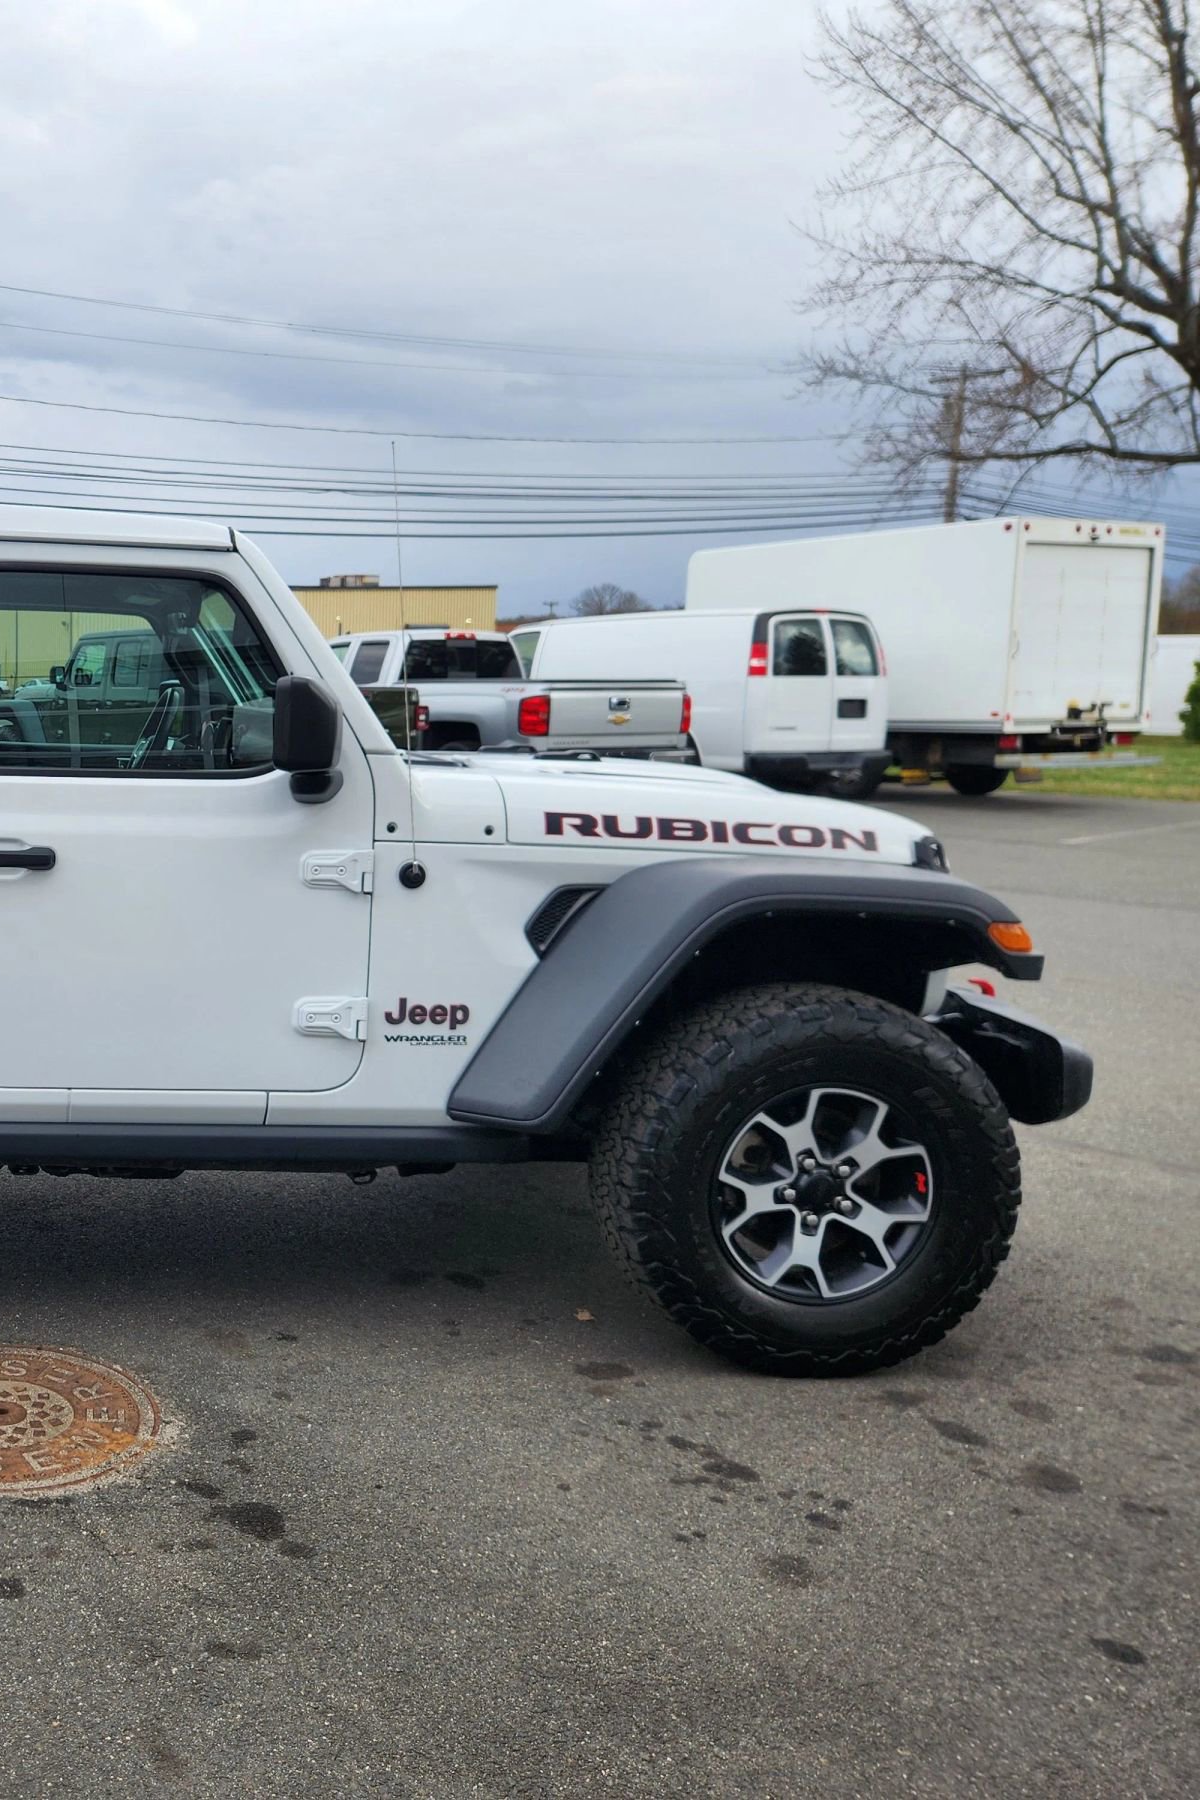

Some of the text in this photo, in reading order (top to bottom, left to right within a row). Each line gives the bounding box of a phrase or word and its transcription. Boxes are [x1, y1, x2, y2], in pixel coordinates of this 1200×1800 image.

[544, 811, 879, 852] RUBICON
[384, 997, 470, 1030] Jeep
[384, 1034, 467, 1042] WRANGLER
